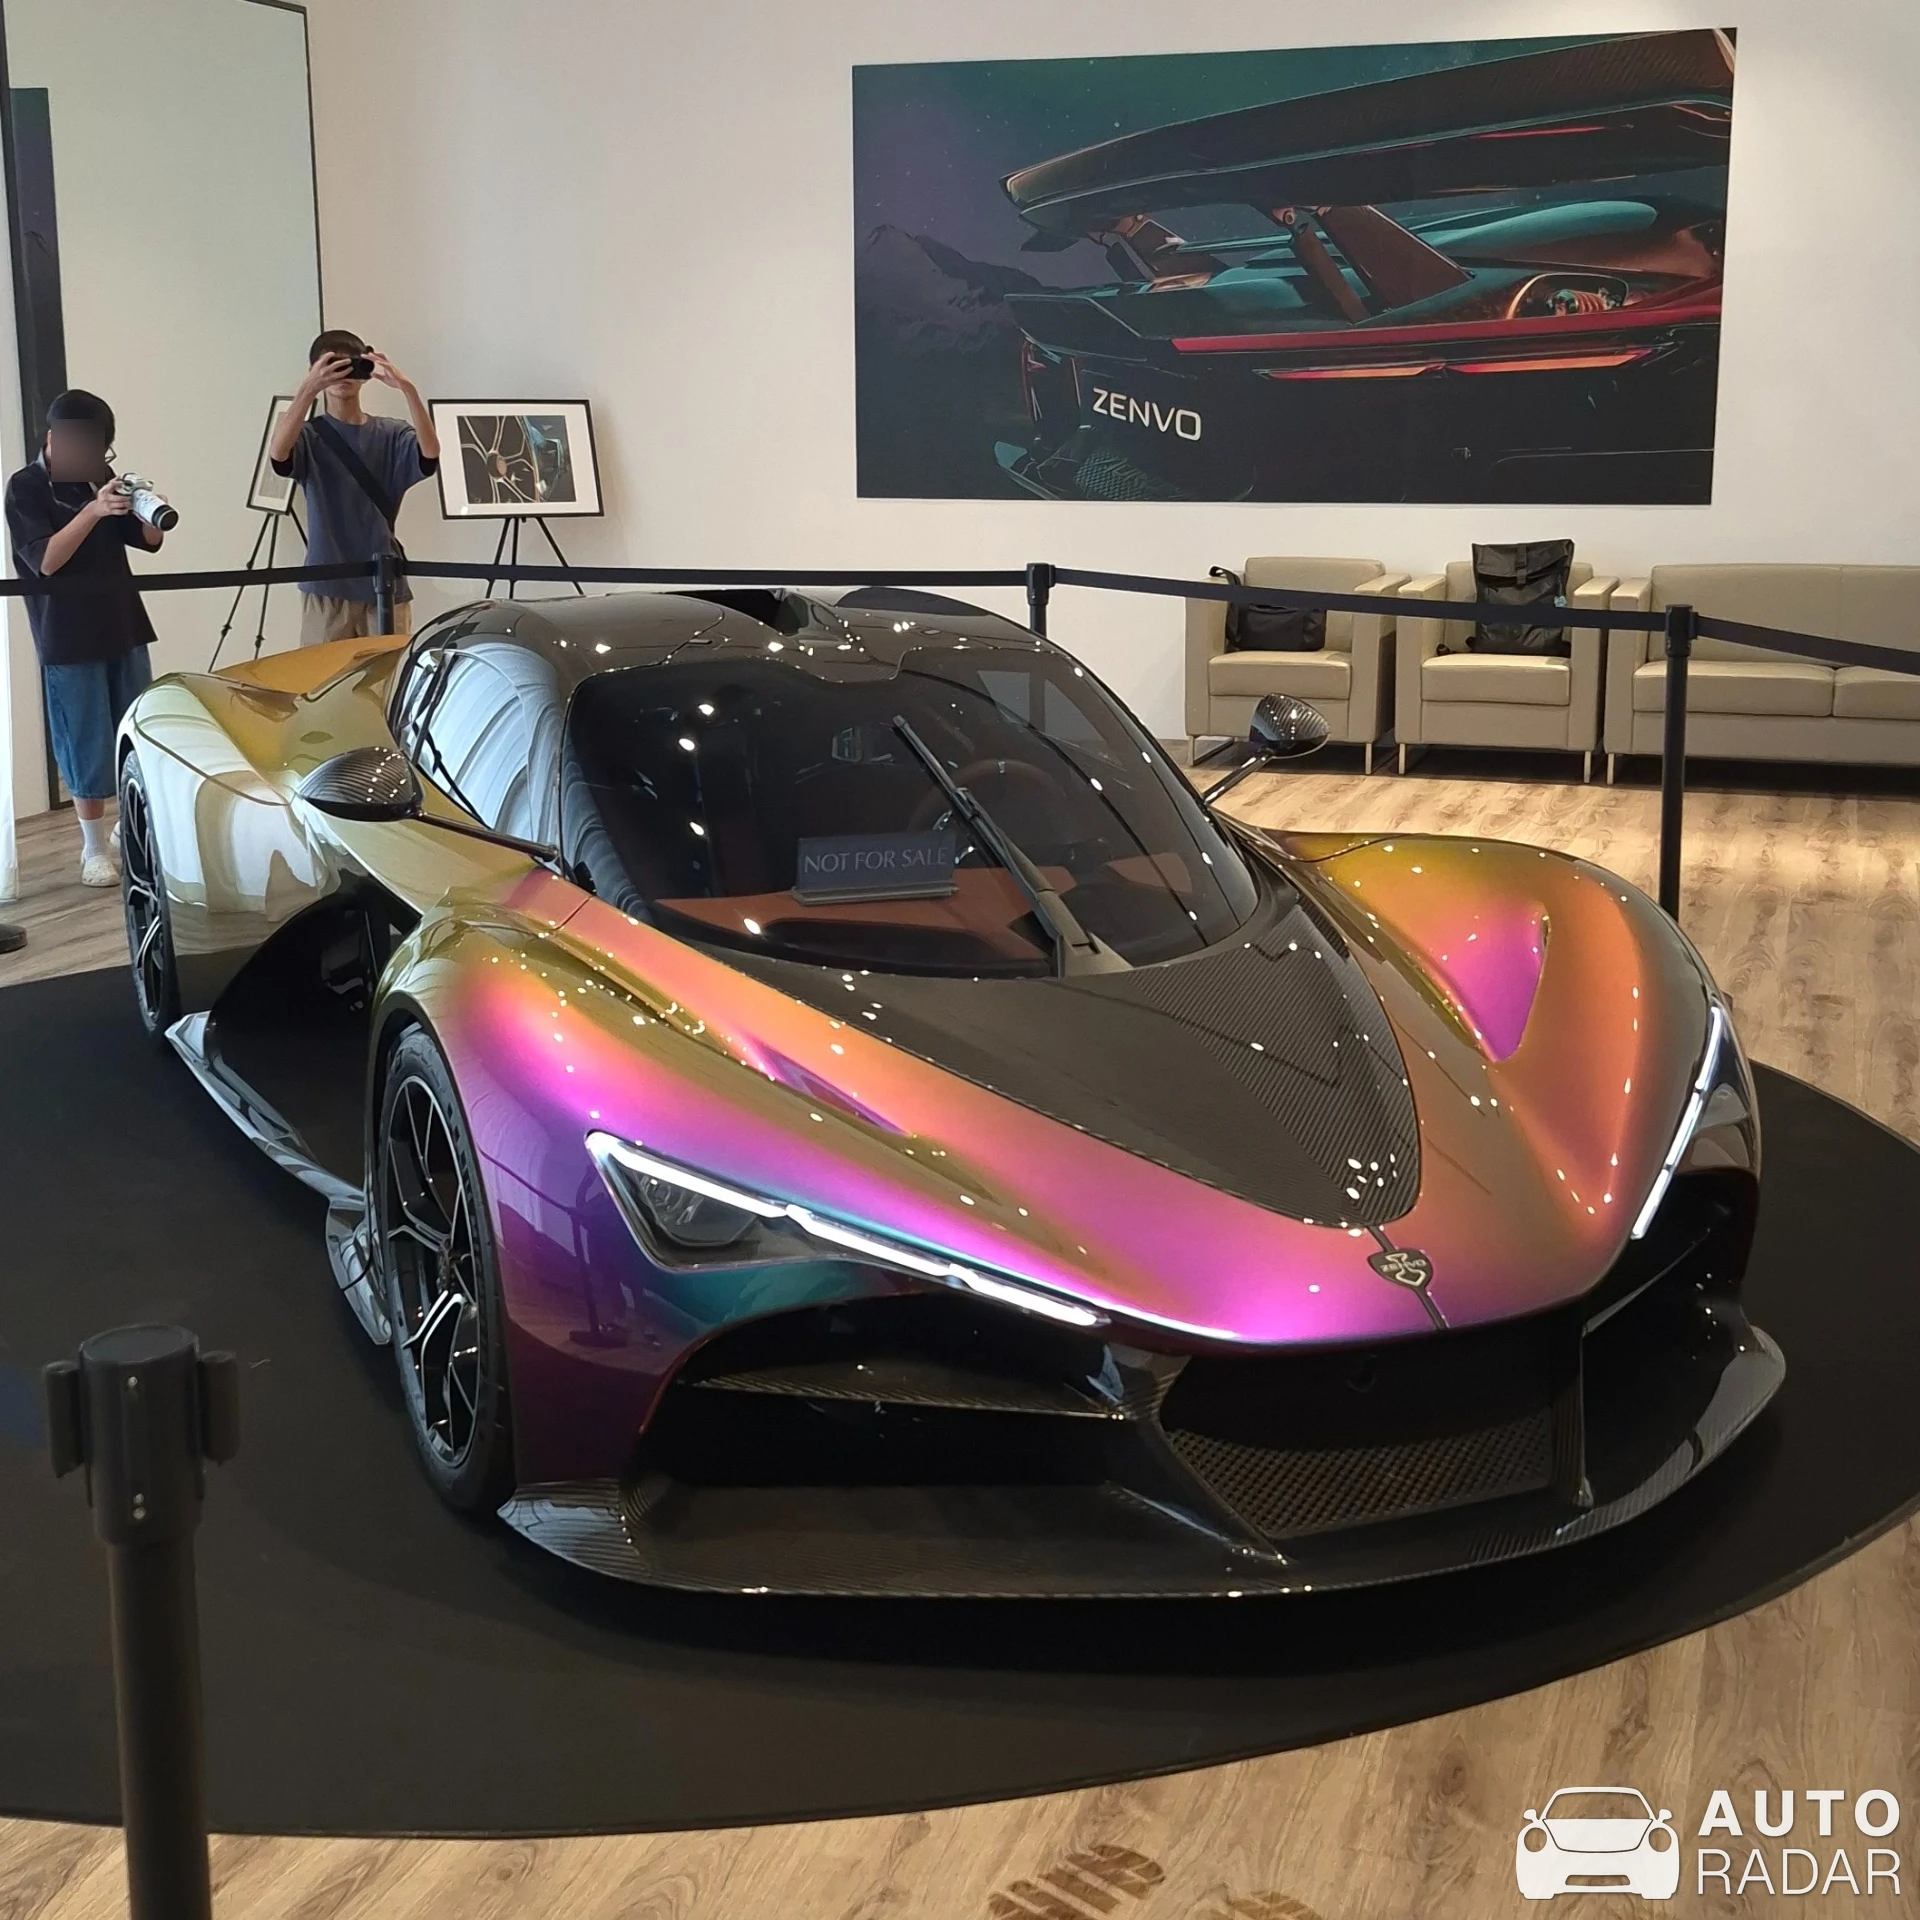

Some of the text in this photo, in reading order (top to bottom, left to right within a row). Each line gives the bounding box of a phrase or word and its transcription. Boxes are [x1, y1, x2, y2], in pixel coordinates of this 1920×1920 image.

[1092, 387, 1202, 441] ZENVO
[804, 847, 948, 873] NOT FOR SALE
[1379, 1258, 1427, 1273] ZEVO
